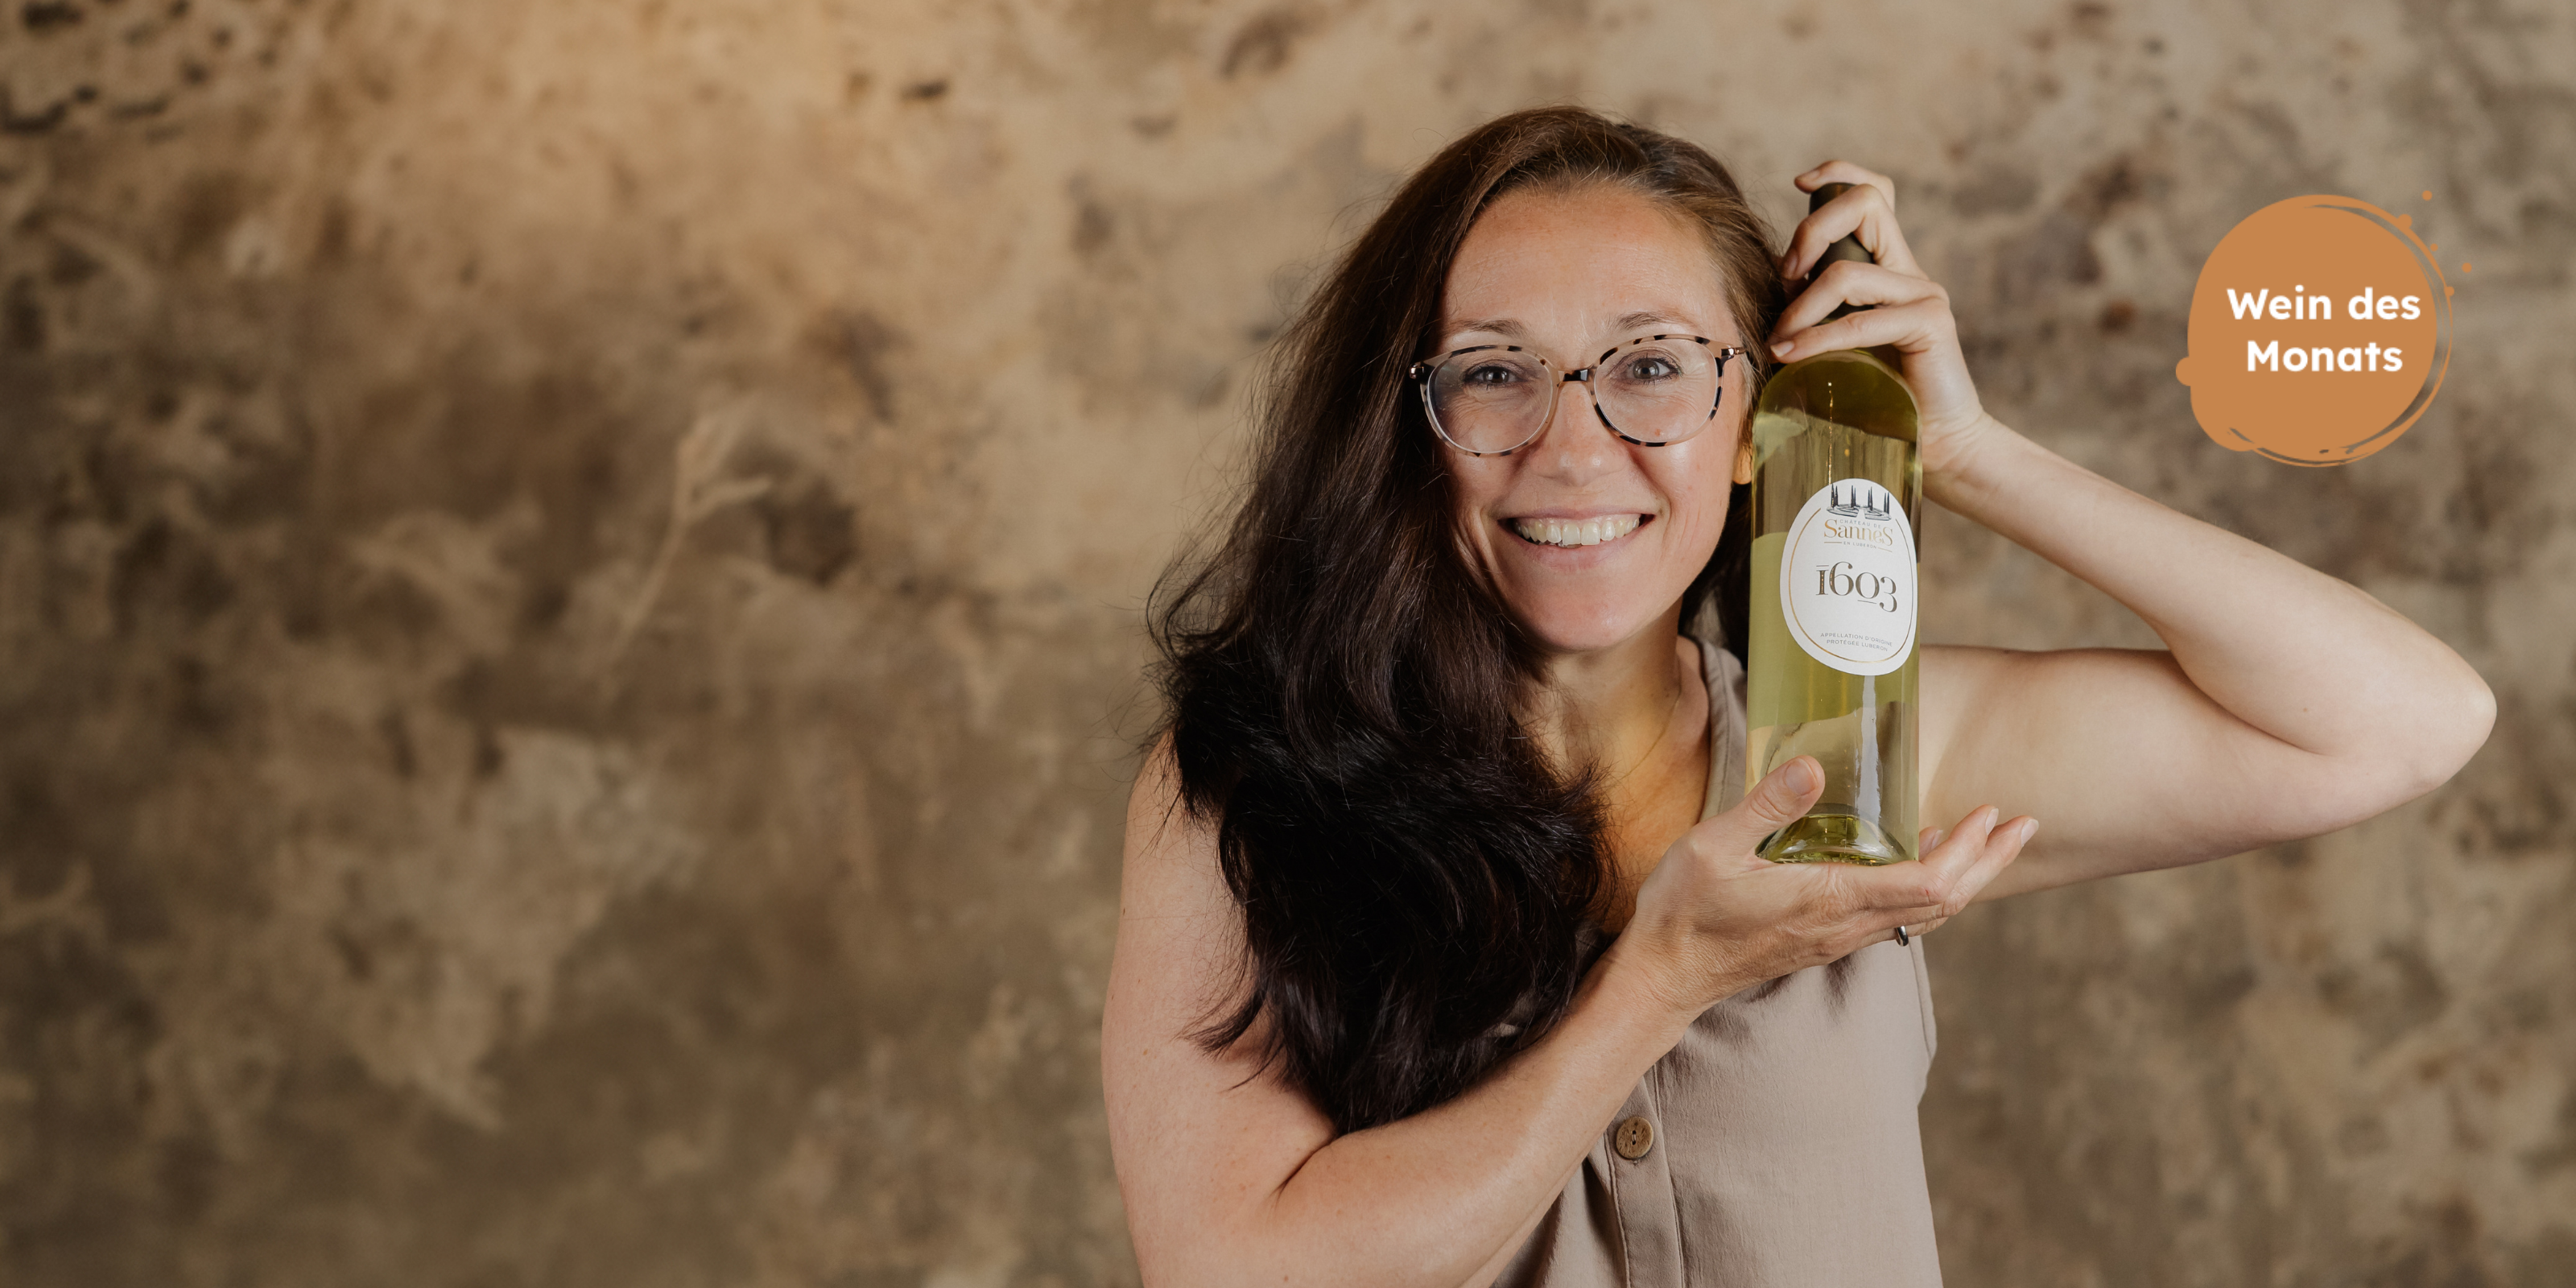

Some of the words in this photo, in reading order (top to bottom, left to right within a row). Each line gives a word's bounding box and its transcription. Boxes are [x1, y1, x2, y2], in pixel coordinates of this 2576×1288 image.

[1839, 518, 1871, 526] CHÂTEAU
[1820, 632, 1864, 640] APPELLATION
[1861, 642, 1888, 652] LUBERON
